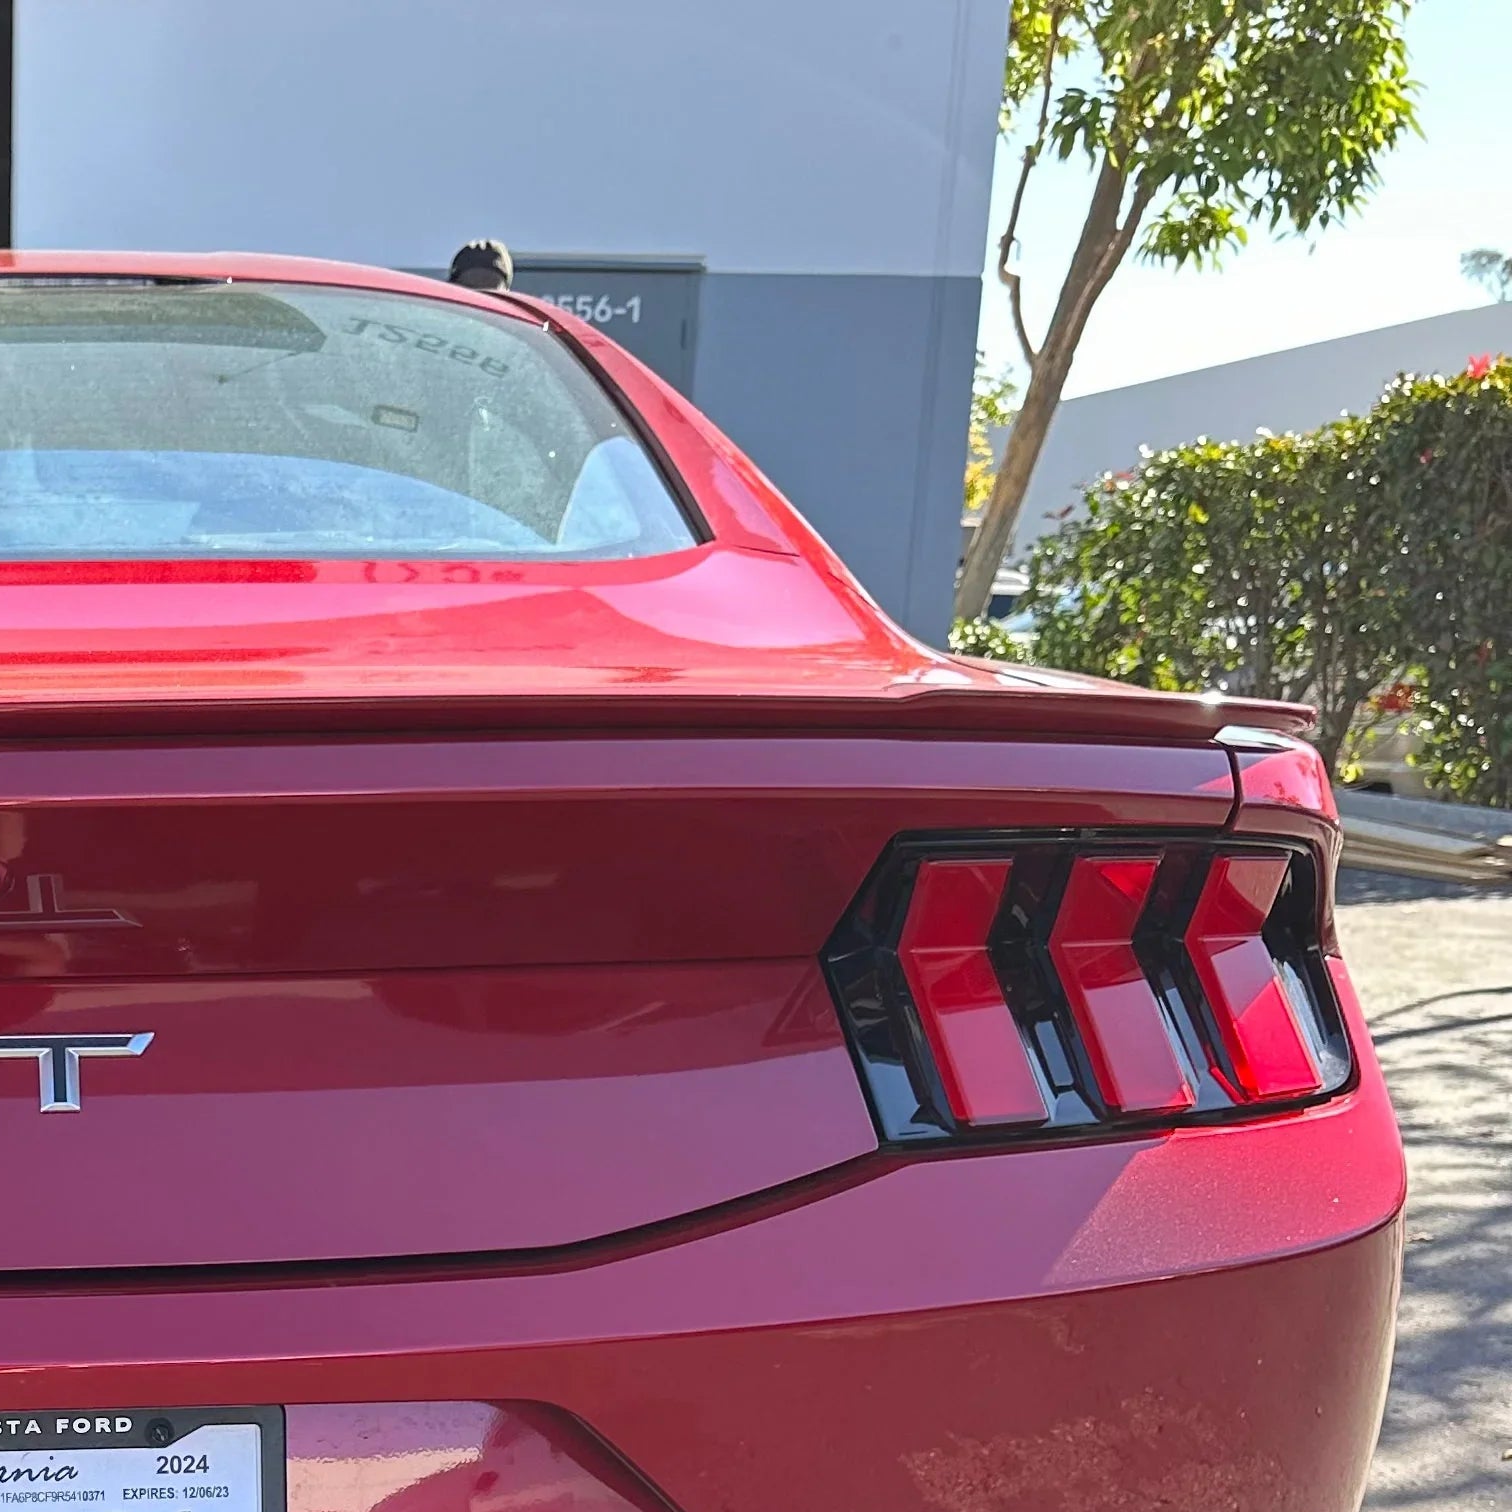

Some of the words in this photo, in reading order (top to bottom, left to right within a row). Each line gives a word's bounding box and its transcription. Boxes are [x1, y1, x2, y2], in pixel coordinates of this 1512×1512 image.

[56, 1417, 132, 1433] FORD
[156, 1455, 209, 1474] 2024
[122, 1487, 179, 1500] EXPIRES:
[182, 1486, 229, 1498] 12/06/23
